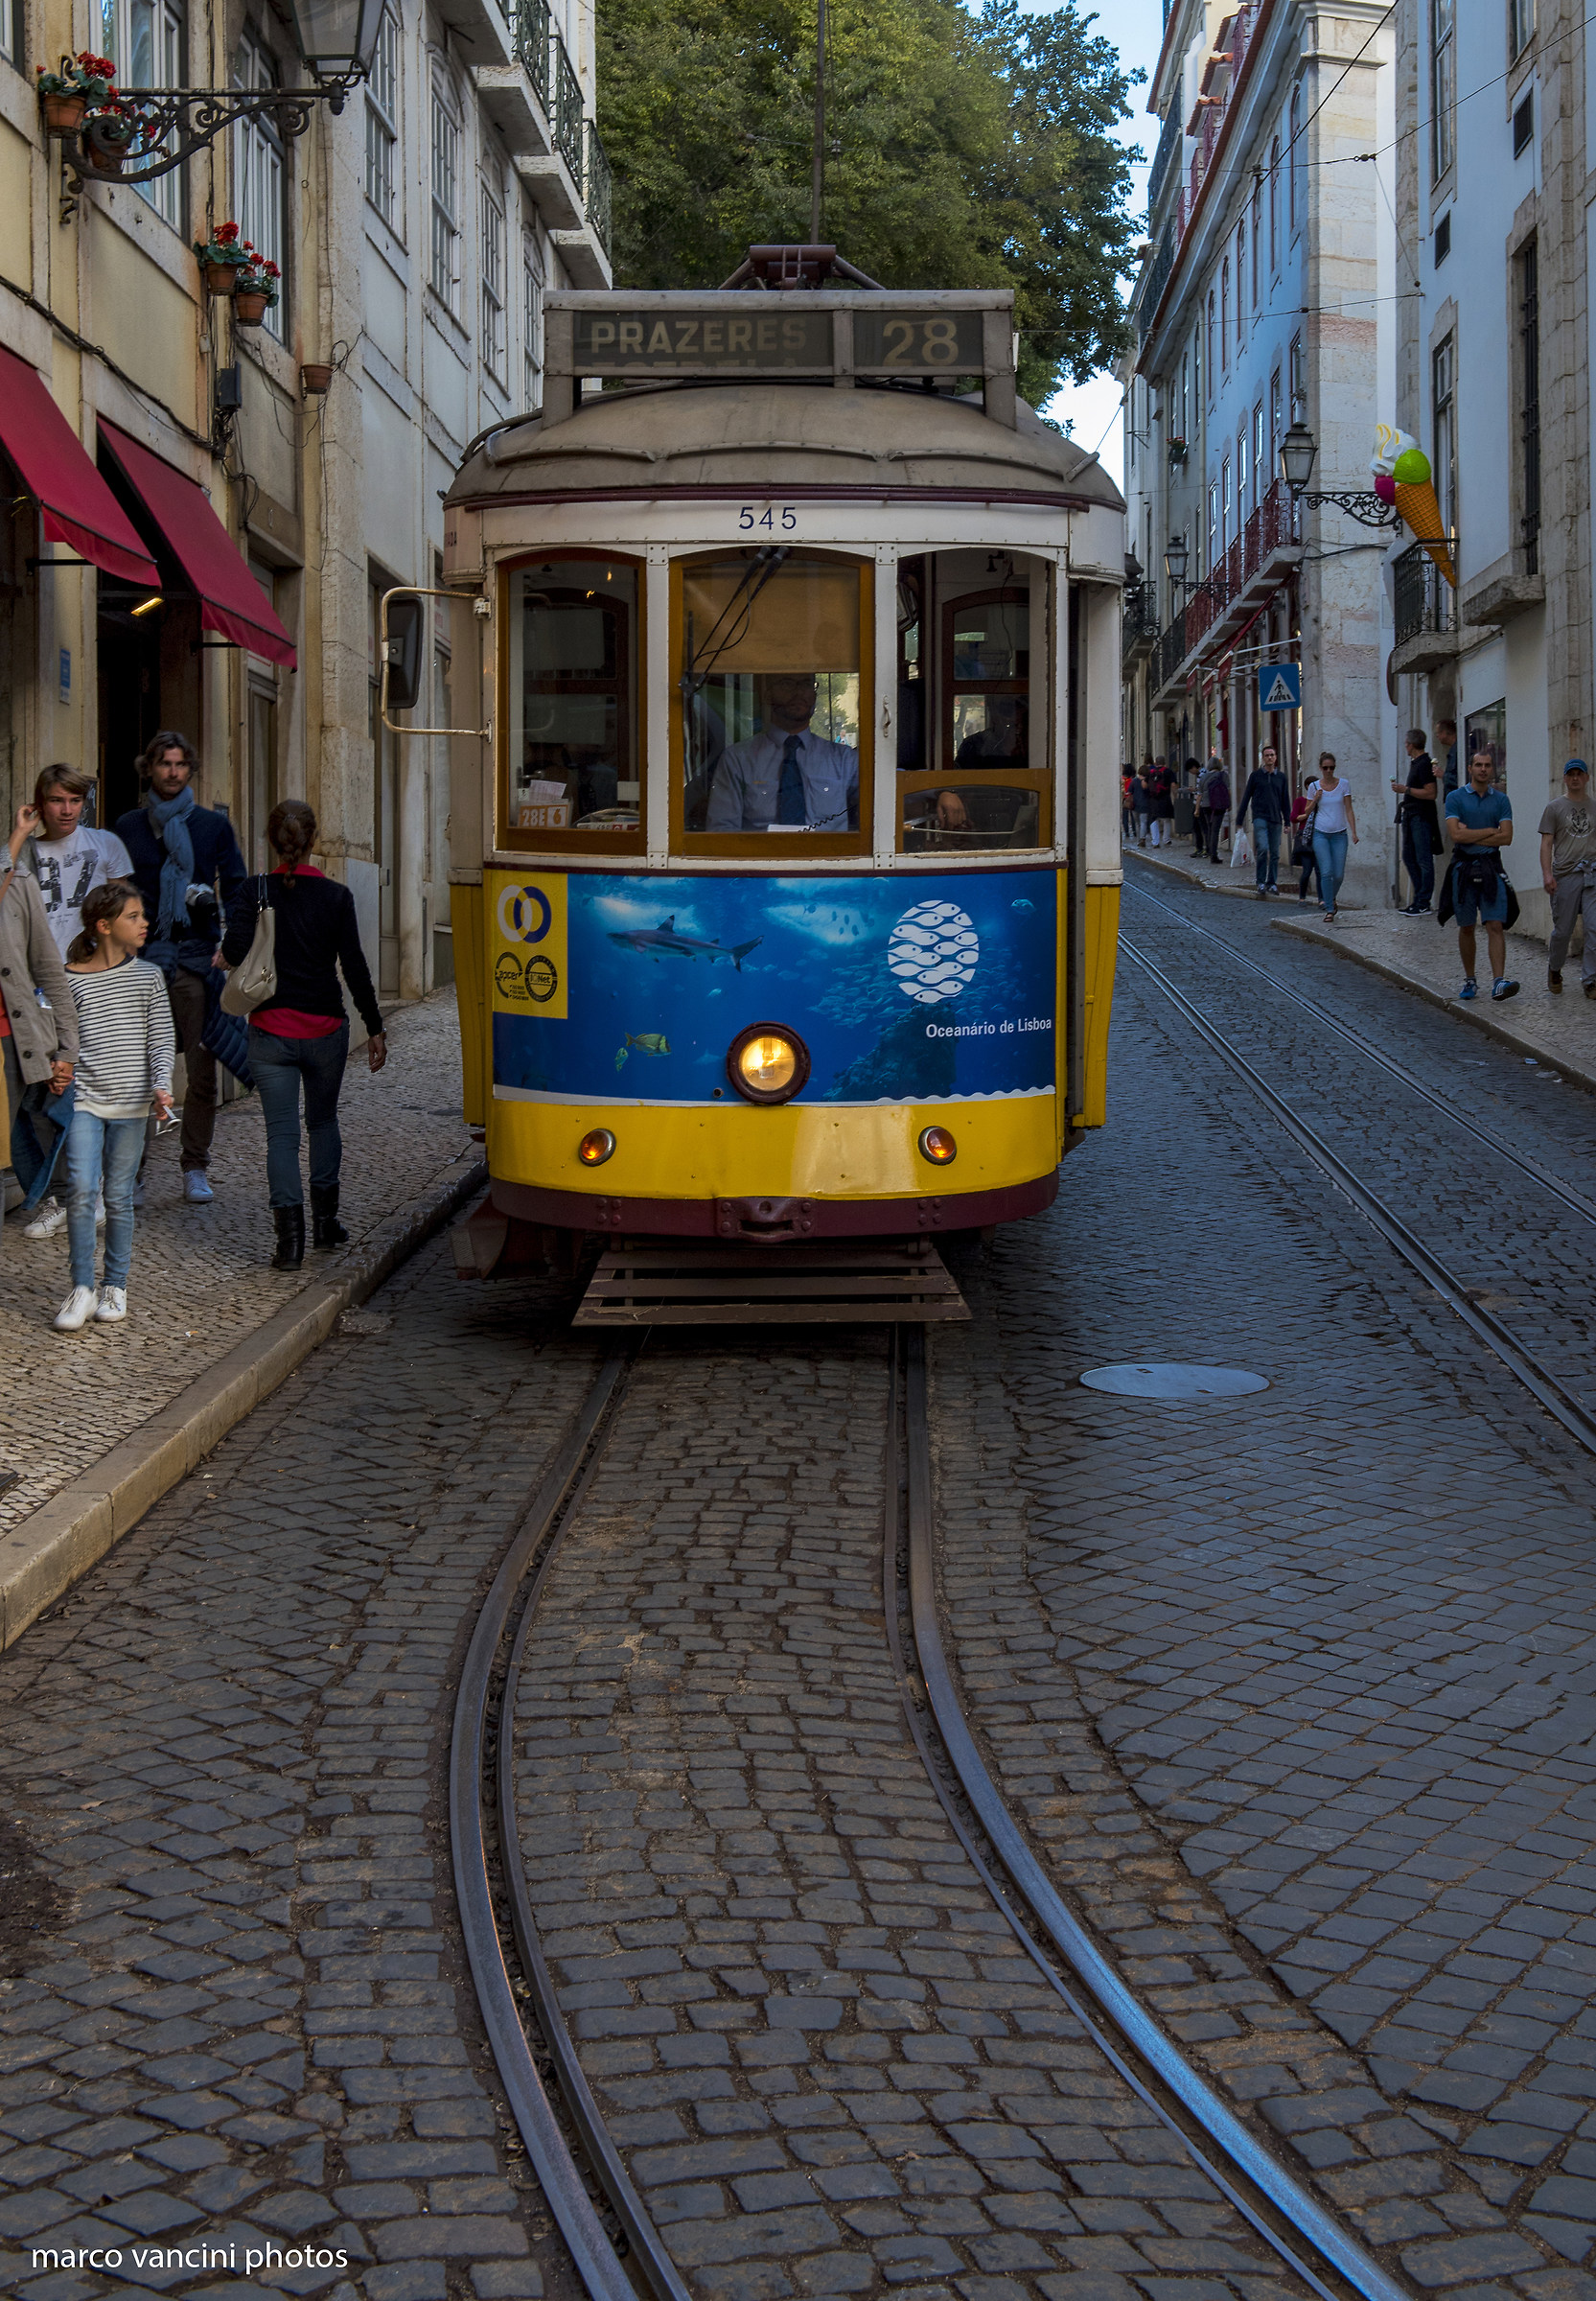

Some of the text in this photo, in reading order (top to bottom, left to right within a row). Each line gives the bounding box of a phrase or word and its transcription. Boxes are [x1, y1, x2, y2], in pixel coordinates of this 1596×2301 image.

[591, 317, 807, 355] PRAZERES
[881, 318, 960, 367] 28
[739, 506, 797, 530] 545
[520, 808, 562, 827] 28E 6
[925, 1017, 1052, 1038] Oceanário de Lisboa
